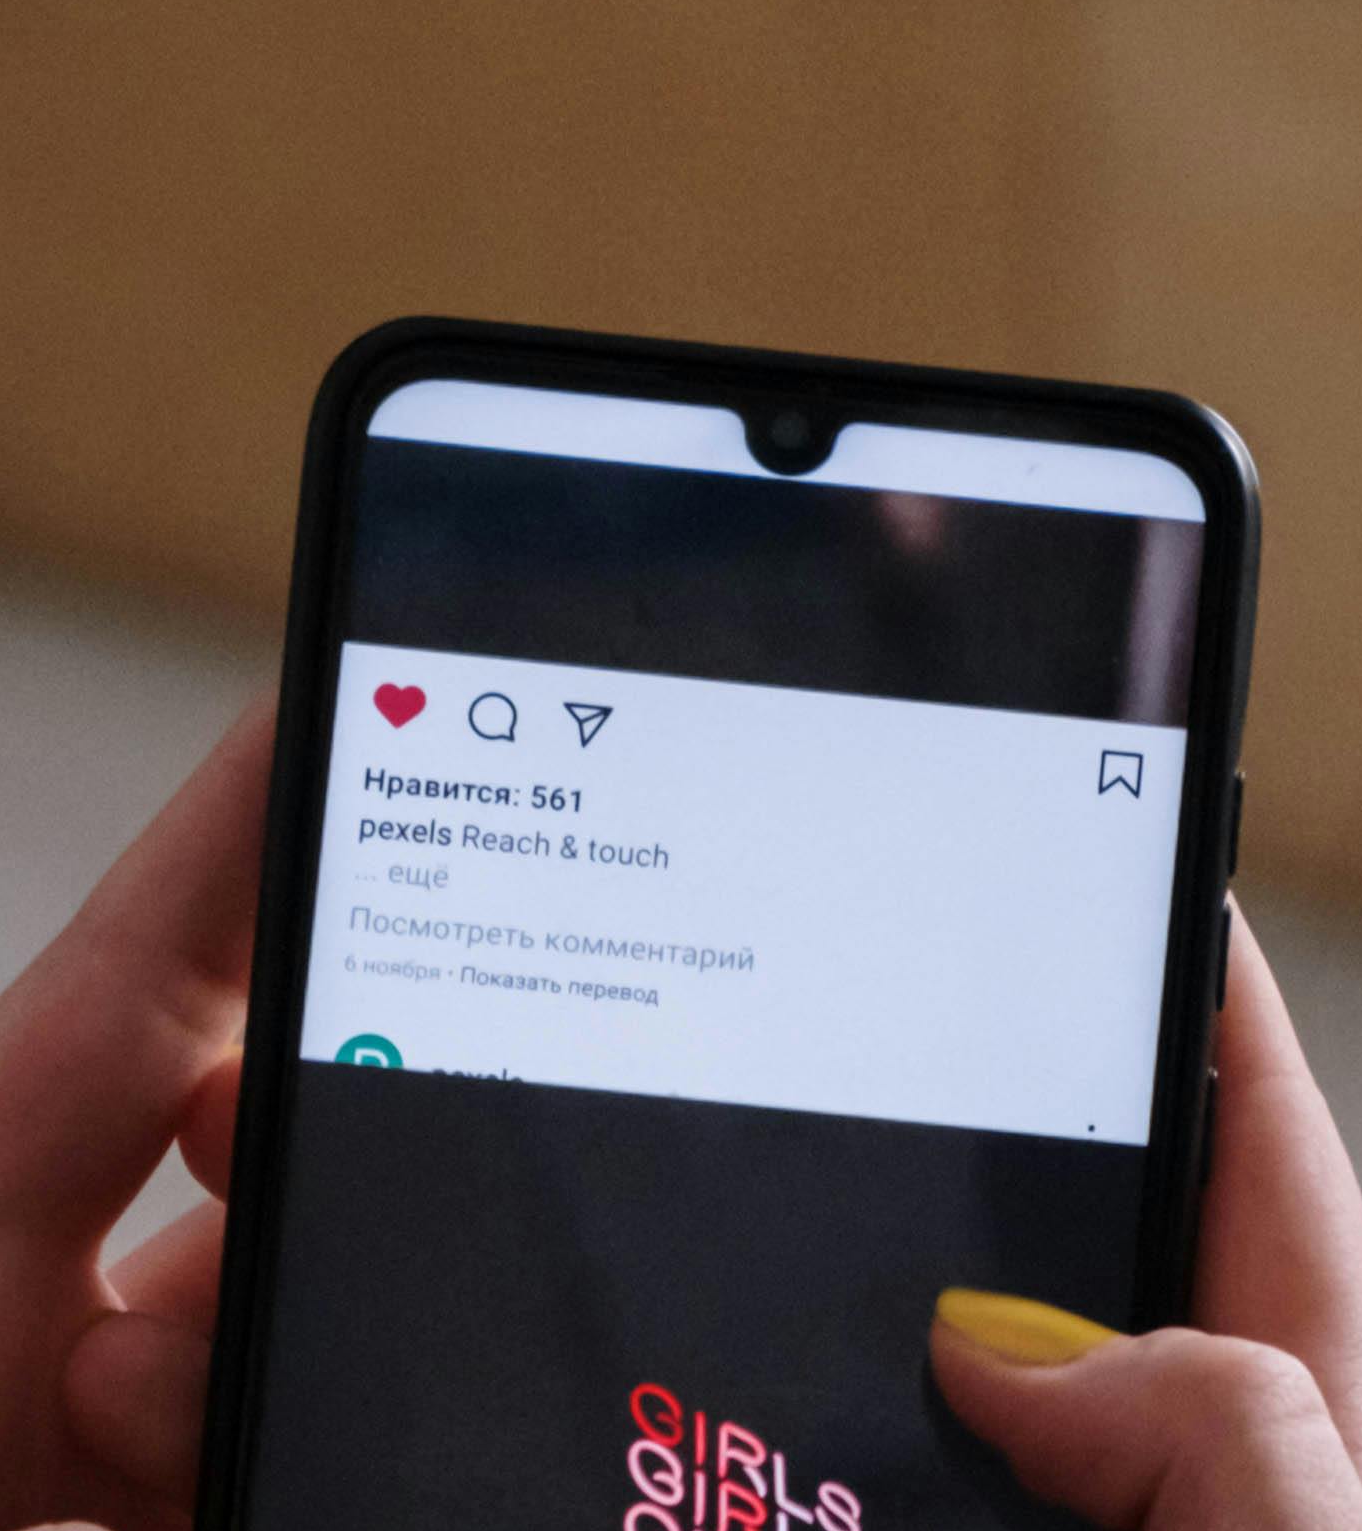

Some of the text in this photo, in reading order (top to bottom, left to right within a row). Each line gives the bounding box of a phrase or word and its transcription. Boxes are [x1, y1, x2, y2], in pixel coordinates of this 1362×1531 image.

[364, 767, 583, 813] Нравится: 561
[358, 817, 670, 870] pexels Reach & touch
[388, 864, 450, 890] ещё
[348, 905, 756, 973] Посмотреть комментарий
[343, 953, 660, 1007] 6 ноября Показать перевод
